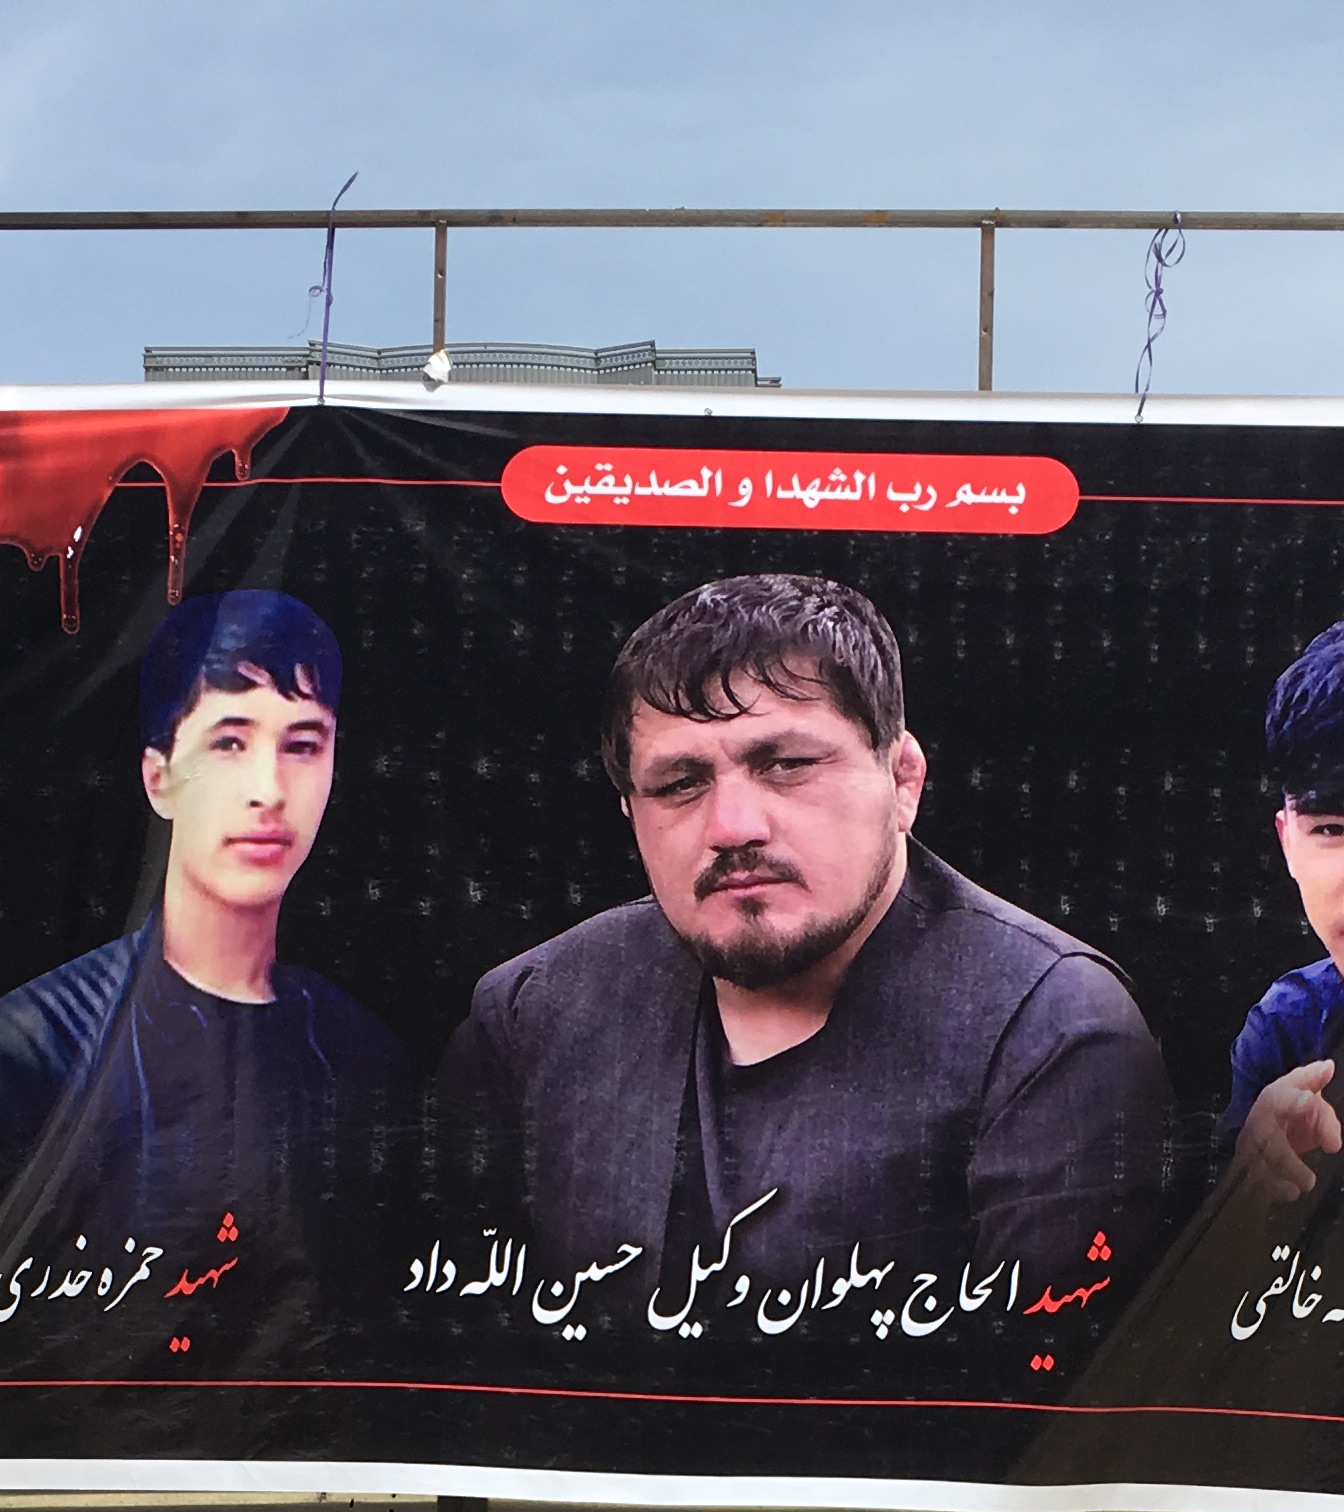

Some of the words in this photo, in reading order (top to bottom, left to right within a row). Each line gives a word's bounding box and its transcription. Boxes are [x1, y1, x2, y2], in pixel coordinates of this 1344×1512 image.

[544, 463, 723, 505] الصدیقین
[729, 477, 753, 507] و
[765, 467, 876, 509] الشهدا
[887, 483, 938, 513] رب
[946, 482, 1026, 515] بسم
[96, 1236, 164, 1312] حمزه
[164, 1212, 238, 1353] شهید
[403, 1239, 457, 1293] داد
[532, 1243, 643, 1341] حسین
[647, 1187, 778, 1339] وکیل
[757, 1241, 895, 1340] پهلوان
[900, 1259, 1020, 1337] الحاج
[1024, 1231, 1112, 1371] شهید
[1230, 1244, 1323, 1341] خالقی
